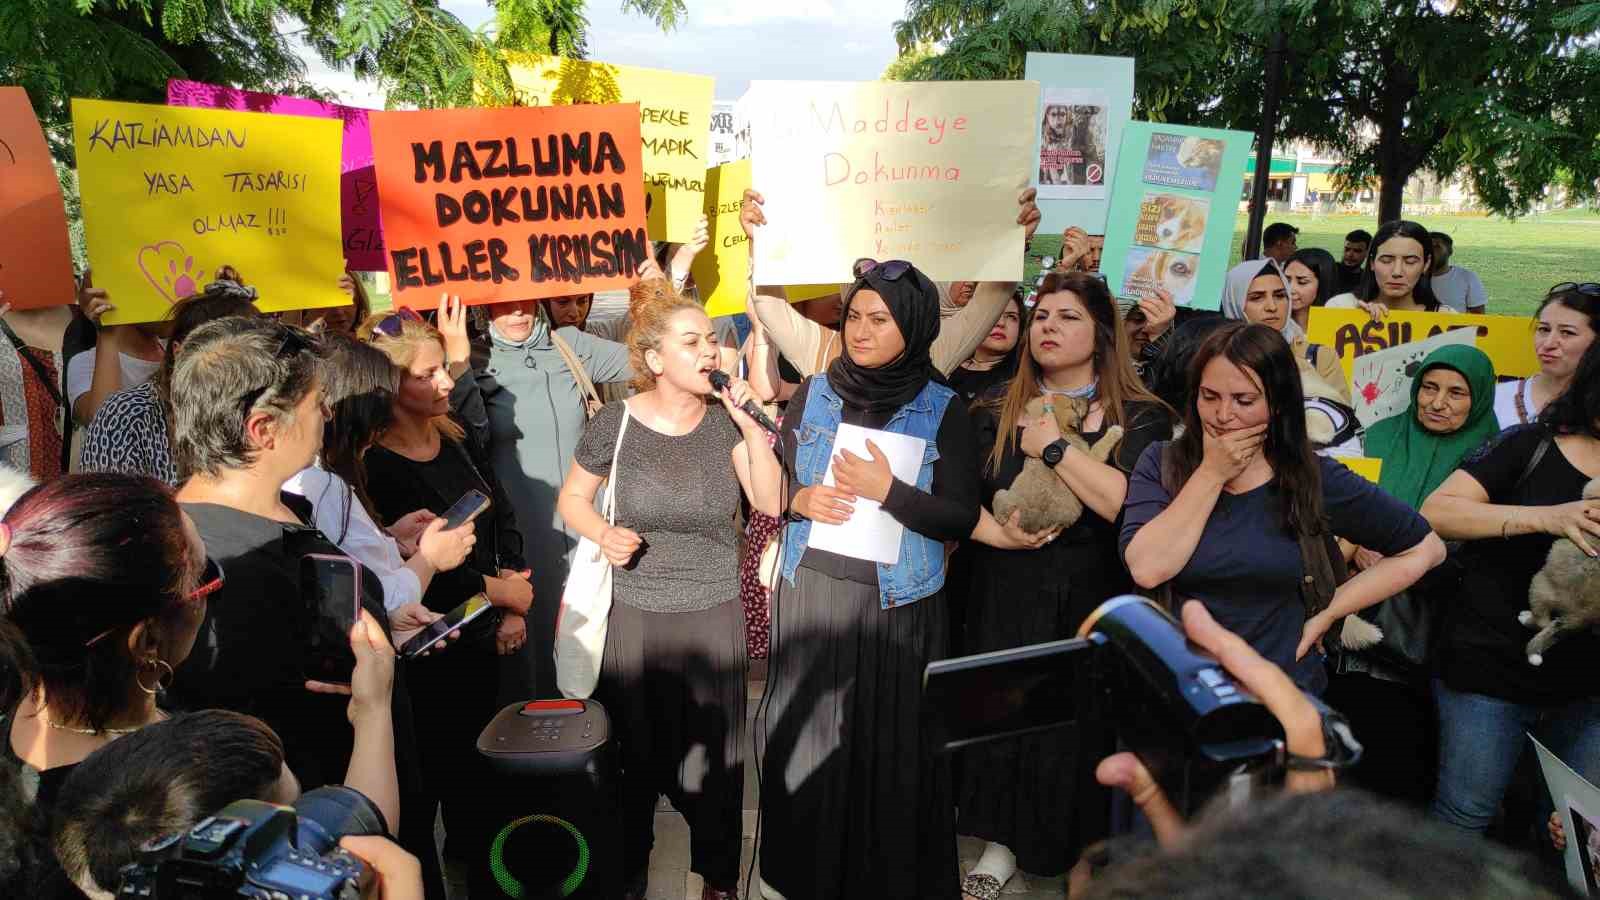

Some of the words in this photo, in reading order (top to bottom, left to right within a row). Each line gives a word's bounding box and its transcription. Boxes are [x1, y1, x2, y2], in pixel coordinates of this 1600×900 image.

[89, 117, 247, 152] KATLİAMDAN
[640, 108, 689, 126] PEKLE
[808, 96, 969, 144] Maddeye
[411, 131, 626, 183] MAZLUMA
[823, 151, 961, 186] Dokunma
[143, 171, 194, 195] YASA
[224, 172, 307, 192] TASARISI
[435, 182, 626, 227] DOKUNAN
[193, 213, 260, 235] OLMAZ
[391, 238, 519, 291] ELLER
[527, 227, 648, 283] KIRILSIN
